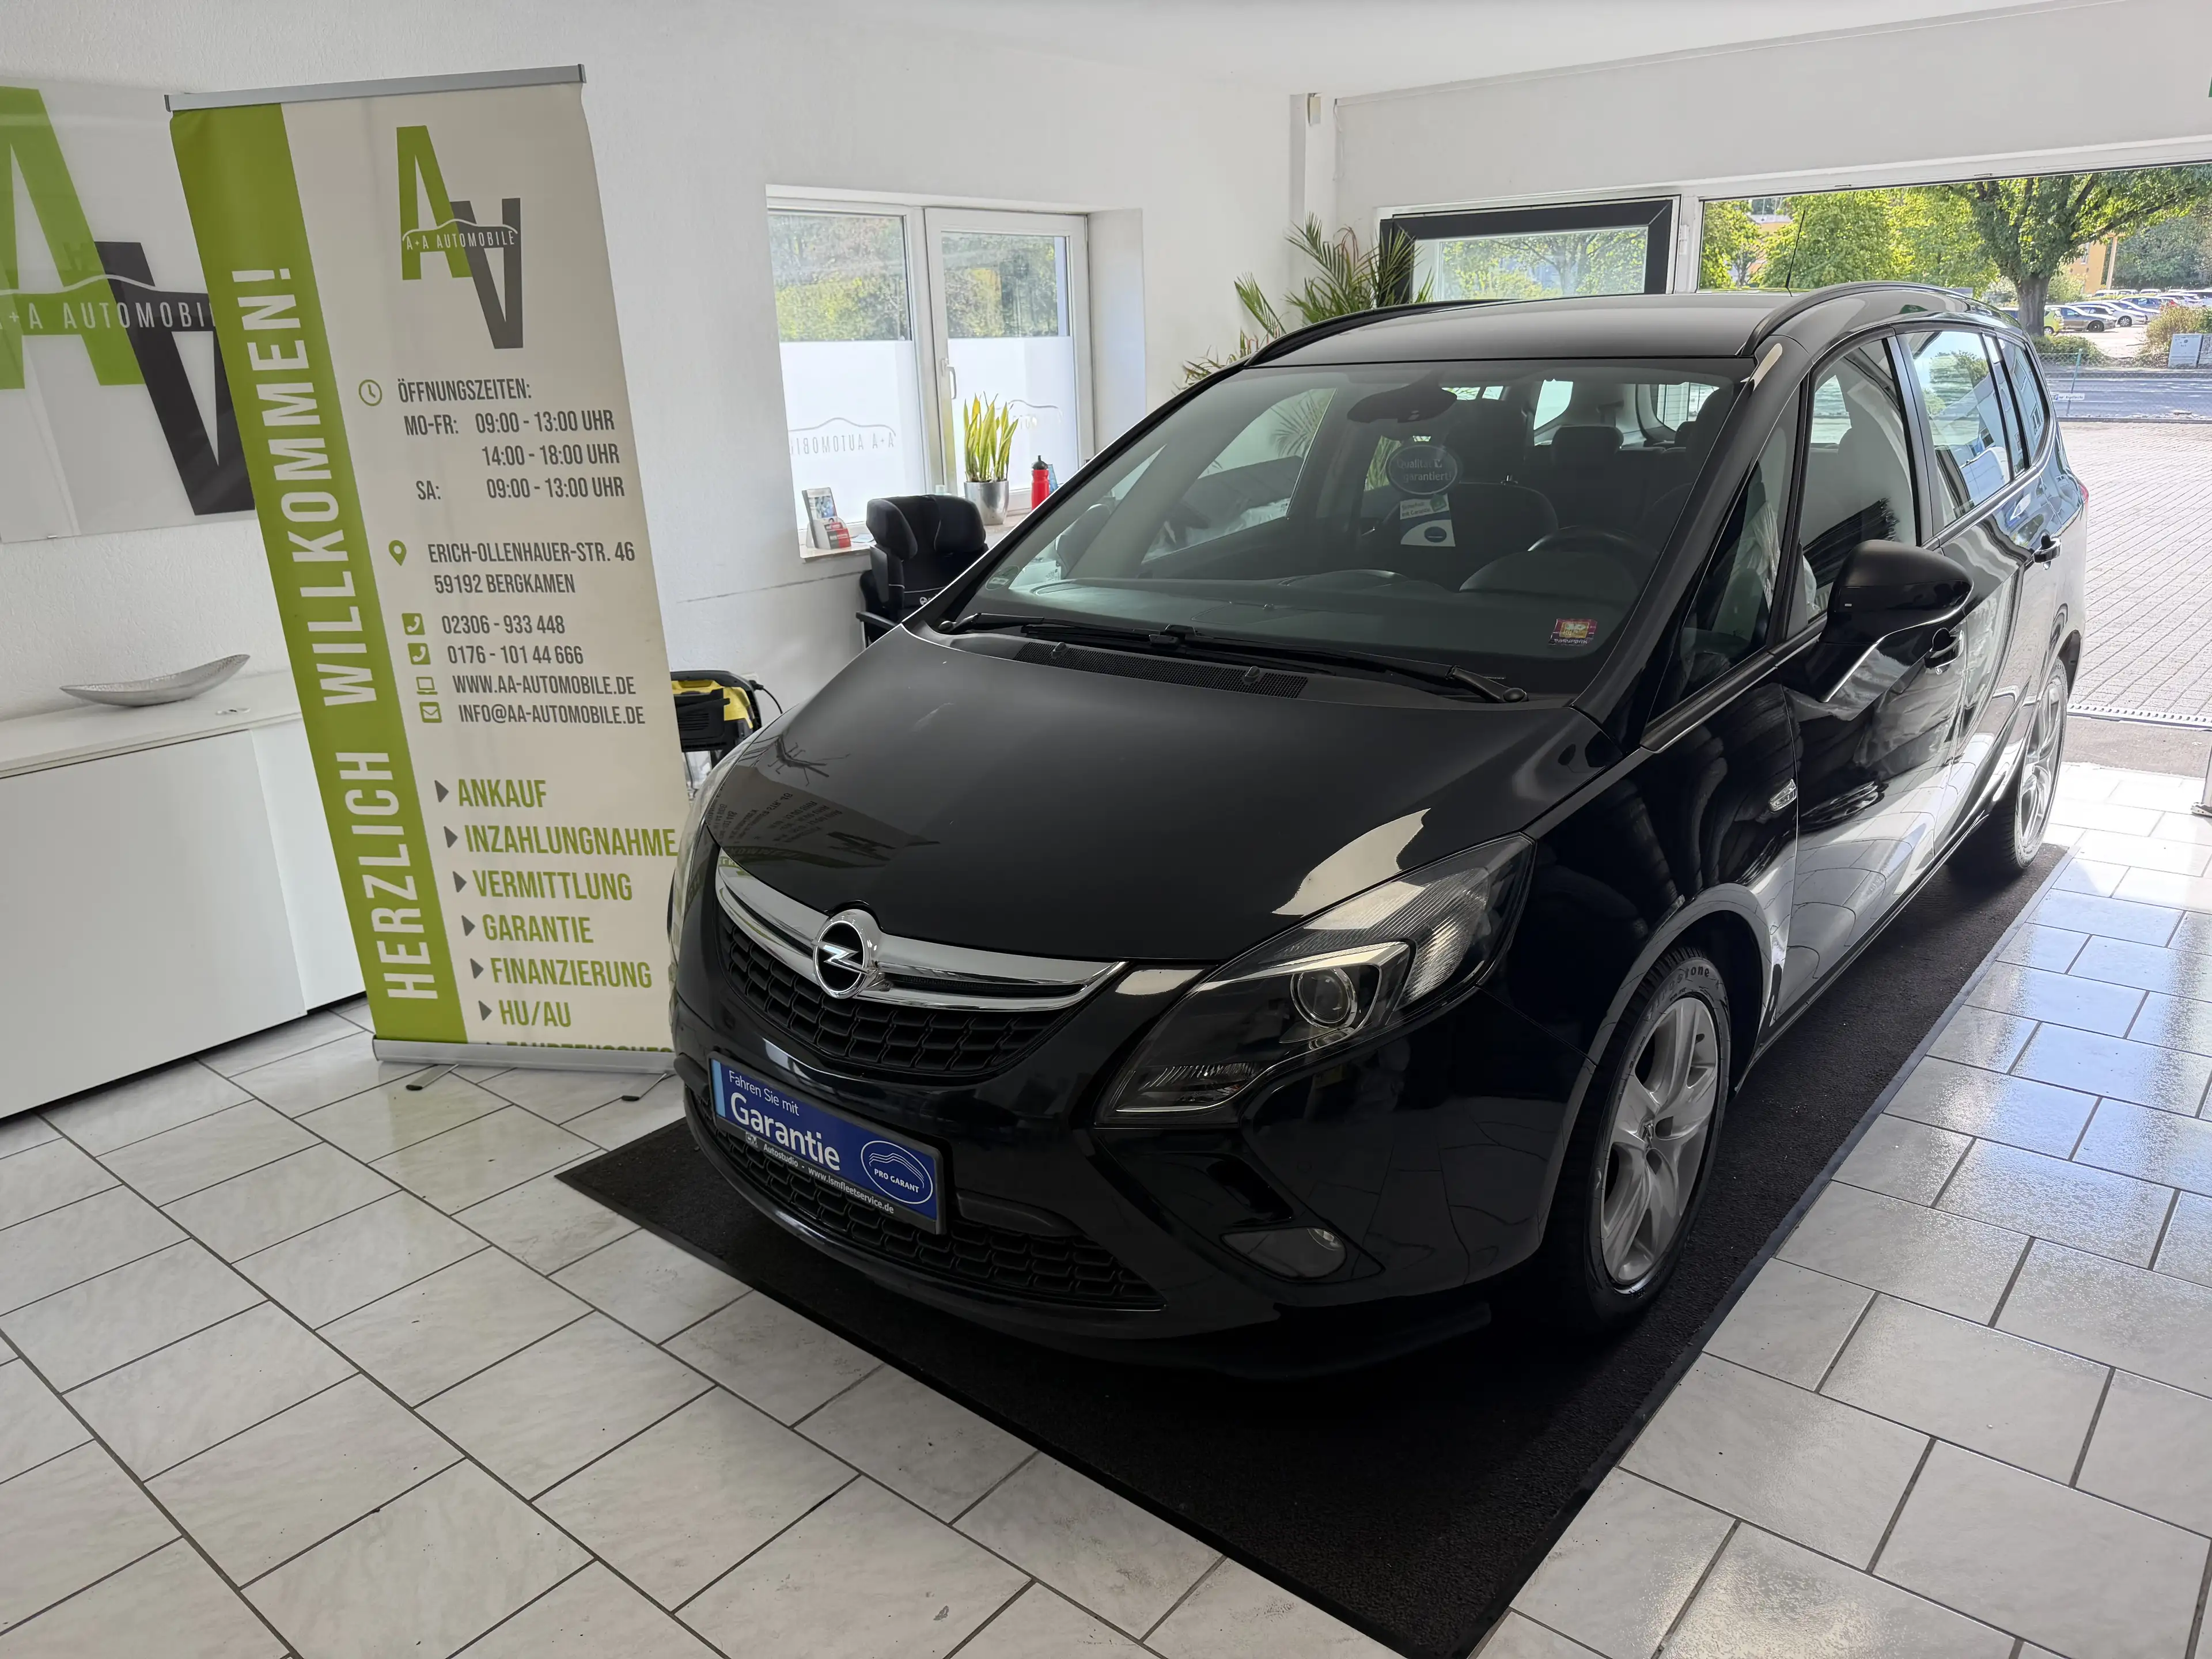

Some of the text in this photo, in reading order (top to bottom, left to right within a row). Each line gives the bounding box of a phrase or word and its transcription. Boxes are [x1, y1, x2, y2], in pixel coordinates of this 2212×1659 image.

[436, 230, 515, 248] AUTOMOBILE
[0, 302, 43, 330] +A
[398, 378, 532, 403] ÖFFNUNGSZEITEN:
[404, 415, 459, 435] MO-FR:
[475, 413, 519, 434] 09:00
[534, 411, 577, 433] 13:00
[582, 410, 615, 431] UHR
[482, 445, 525, 466] 14:00
[540, 444, 583, 465] 18:00
[587, 444, 620, 464] UHR
[416, 481, 441, 500] SA:
[486, 478, 530, 499] 09:00
[544, 478, 588, 498] 13:00
[592, 476, 625, 497] UHR
[428, 542, 635, 563] ERICH-OLLENHAUER-STR. 46
[434, 574, 575, 594] 59192 BERGKAMEN
[442, 615, 490, 634] 02306
[503, 615, 532, 634] 933
[537, 614, 565, 634] 448
[448, 646, 486, 664] 0176
[500, 646, 528, 664] 101
[532, 646, 552, 664] 44
[555, 646, 584, 664] 666
[453, 675, 636, 695] WWW.AA-AUTOMOBILE.DE
[459, 704, 645, 724] INFO@AA-AUTOMOBILE.DE
[459, 779, 547, 808] ANKAUF
[464, 824, 678, 857] INZAHLUNGNAHME
[335, 751, 438, 1000] HERZLICH
[472, 870, 632, 901] VERMITTLUNG
[483, 914, 593, 943] GARANTIE
[490, 957, 652, 988] FINANZIERUNG
[498, 1000, 571, 1028] HU/AU
[729, 1070, 800, 1116] Fahren Sie mit
[730, 1092, 840, 1171] Garantie
[763, 1143, 798, 1168] Autostudio
[874, 1168, 920, 1194] PRO GARANT
